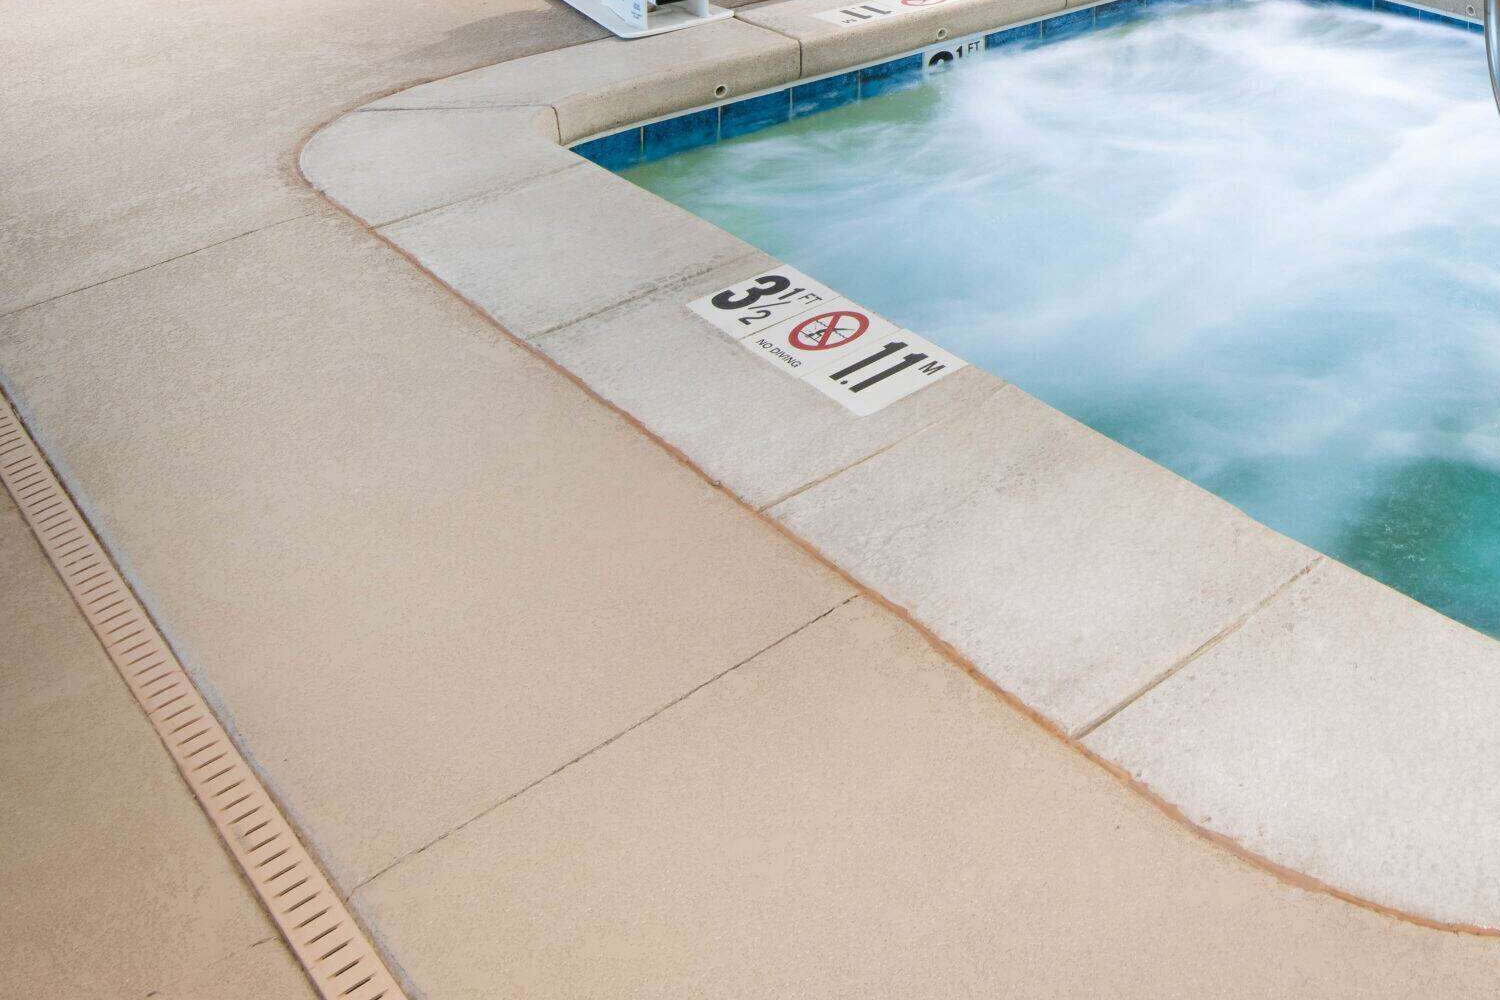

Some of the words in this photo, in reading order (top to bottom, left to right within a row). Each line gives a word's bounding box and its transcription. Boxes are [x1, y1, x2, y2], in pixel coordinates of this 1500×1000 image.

[711, 275, 791, 310] 3
[797, 291, 824, 306] FT
[756, 338, 774, 350] NO
[769, 346, 803, 369] DIVING
[828, 342, 930, 394] 1.1
[918, 360, 947, 376] M
